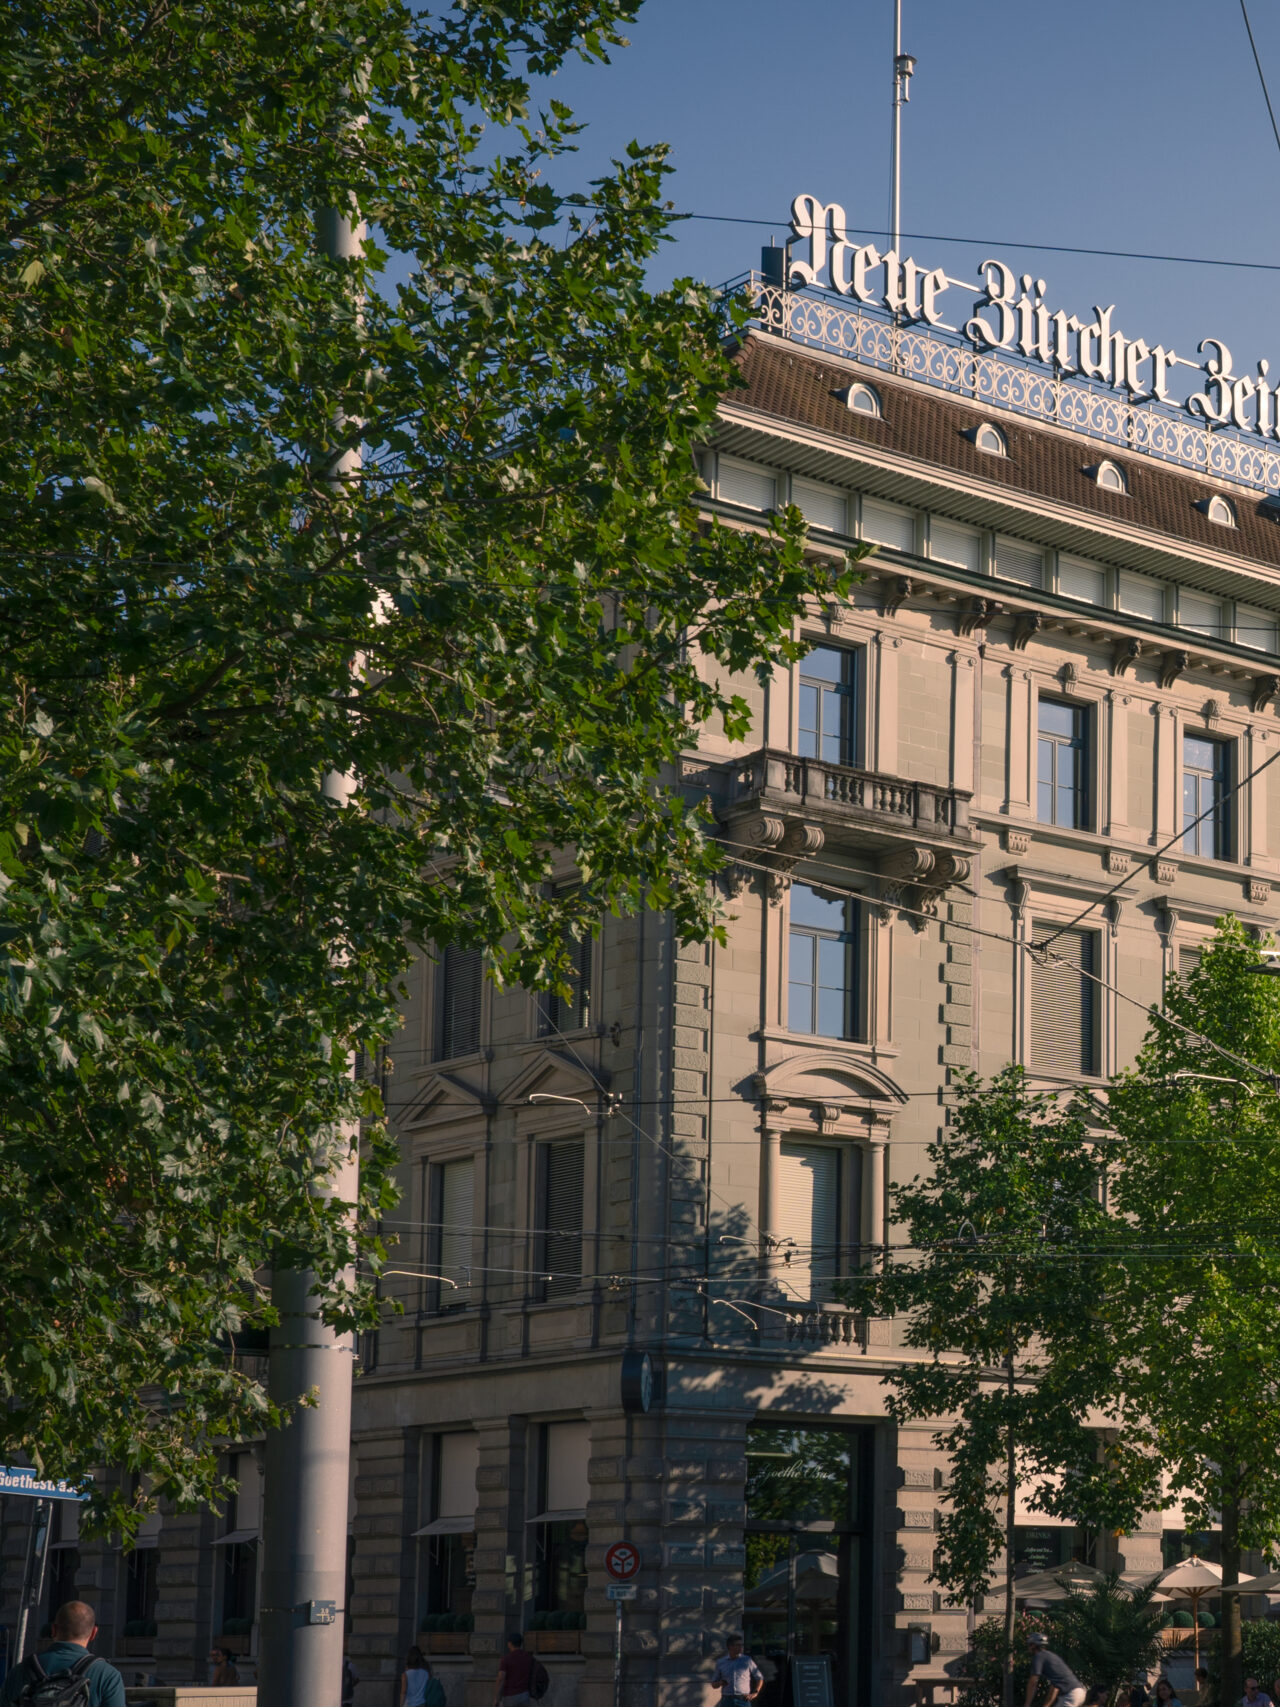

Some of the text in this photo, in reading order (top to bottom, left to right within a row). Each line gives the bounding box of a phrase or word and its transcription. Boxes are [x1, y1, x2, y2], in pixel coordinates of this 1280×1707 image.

[789, 194, 953, 326] Neue
[966, 260, 1178, 402] Zürcher
[0, 1471, 81, 1494] Goethestra
